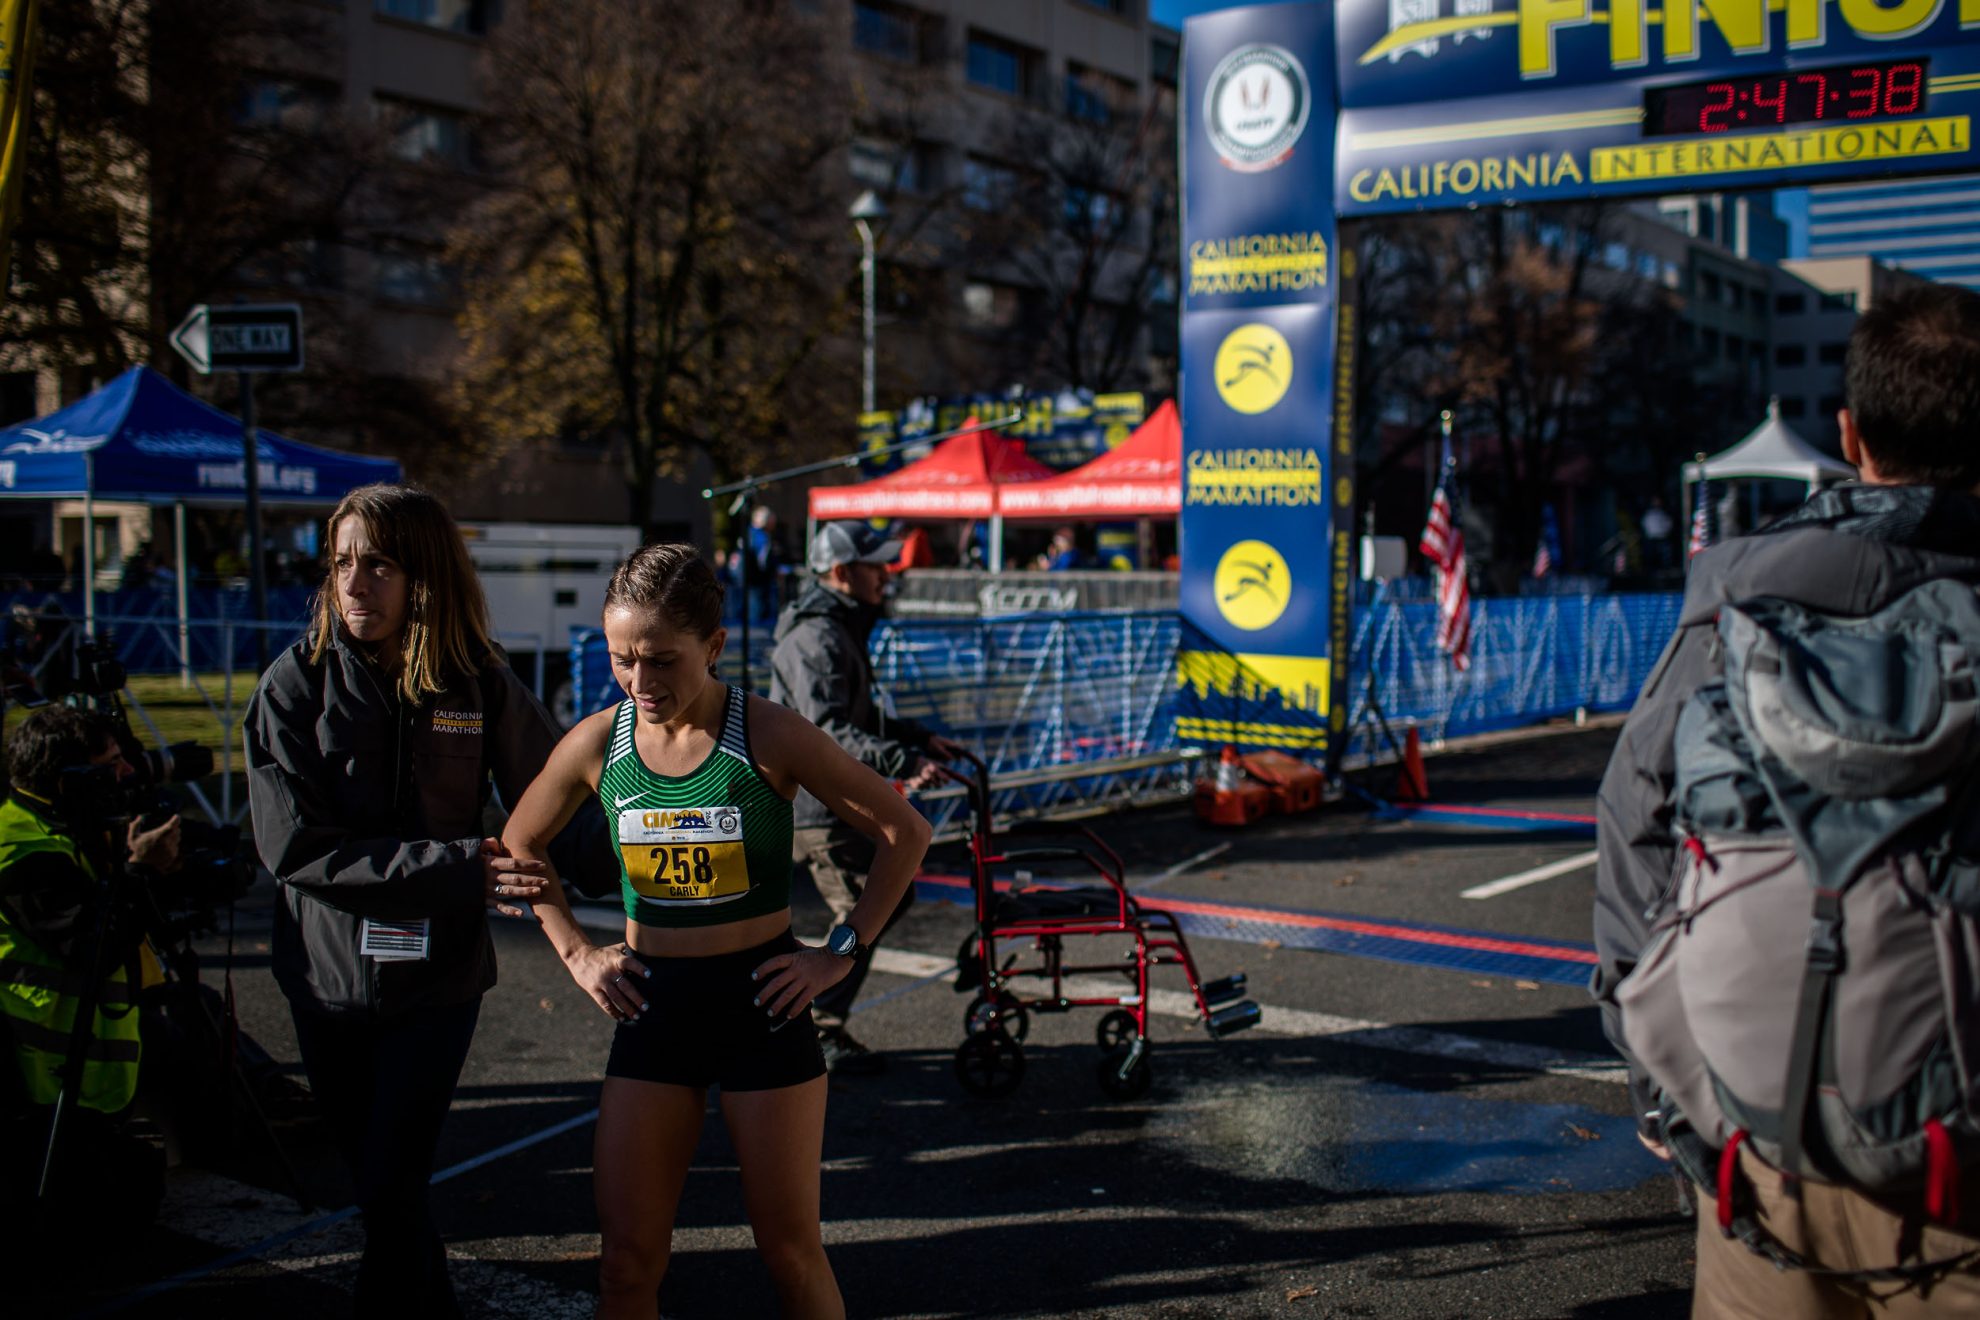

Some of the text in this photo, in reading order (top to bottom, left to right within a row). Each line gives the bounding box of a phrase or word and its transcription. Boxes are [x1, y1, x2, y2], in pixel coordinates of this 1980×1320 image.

[1349, 119, 1964, 203] CALIFORNIA INTERNATIONAL
[1190, 231, 1327, 261] CALIFORNIA
[1189, 270, 1327, 296] MARATHON
[249, 326, 287, 350] WAY
[1187, 449, 1321, 471] CALIFORNIA
[1186, 485, 1321, 506] MARATHON
[434, 710, 482, 719] CALIFORNIA
[651, 847, 713, 885] 258
[669, 886, 700, 897] CARLY
